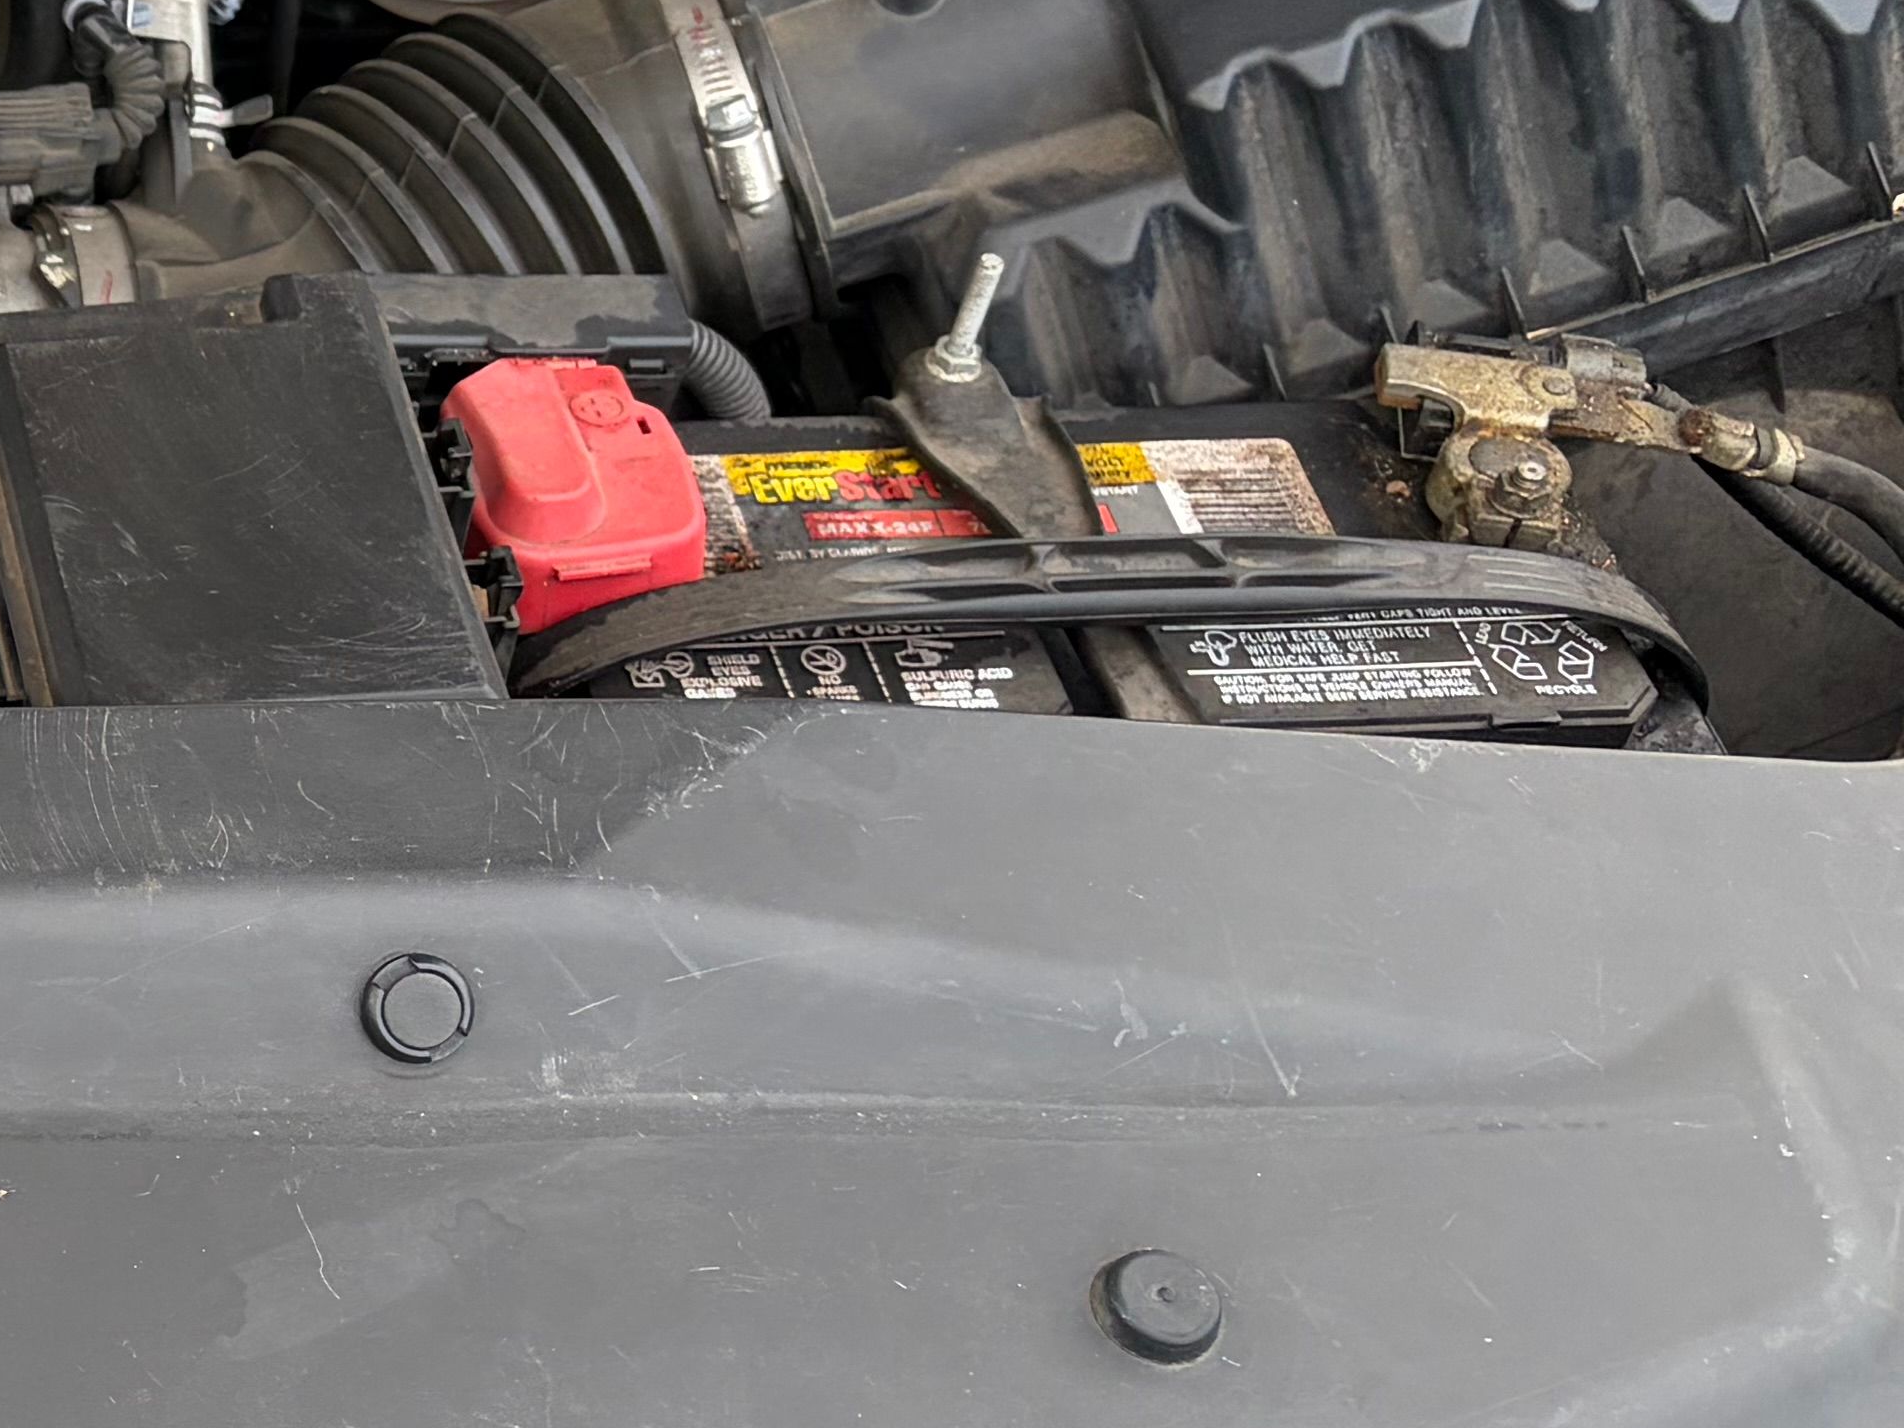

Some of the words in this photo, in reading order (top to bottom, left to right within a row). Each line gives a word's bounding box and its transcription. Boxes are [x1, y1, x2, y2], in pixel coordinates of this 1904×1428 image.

[748, 471, 941, 504] EverStart
[1238, 630, 1289, 644] FLUSH
[1291, 629, 1331, 642] EYES
[1333, 625, 1431, 641] IMMEDIATELY
[1243, 643, 1285, 656] WITH
[1346, 639, 1377, 653] GET
[1250, 653, 1318, 667] MEDICAL
[1319, 651, 1359, 665] HELP
[1361, 650, 1401, 664] FAST
[680, 675, 764, 688] EXPLOSIVE
[818, 675, 842, 685] NO
[900, 669, 976, 682] SULFURIC
[978, 667, 1014, 680] ACID
[1268, 673, 1295, 684] FOR
[1363, 669, 1423, 681] STARTING
[1423, 668, 1472, 678] FOLLOW
[1219, 682, 1304, 695] INSTRUCTIONS
[1534, 684, 1598, 696] RECYCLE
